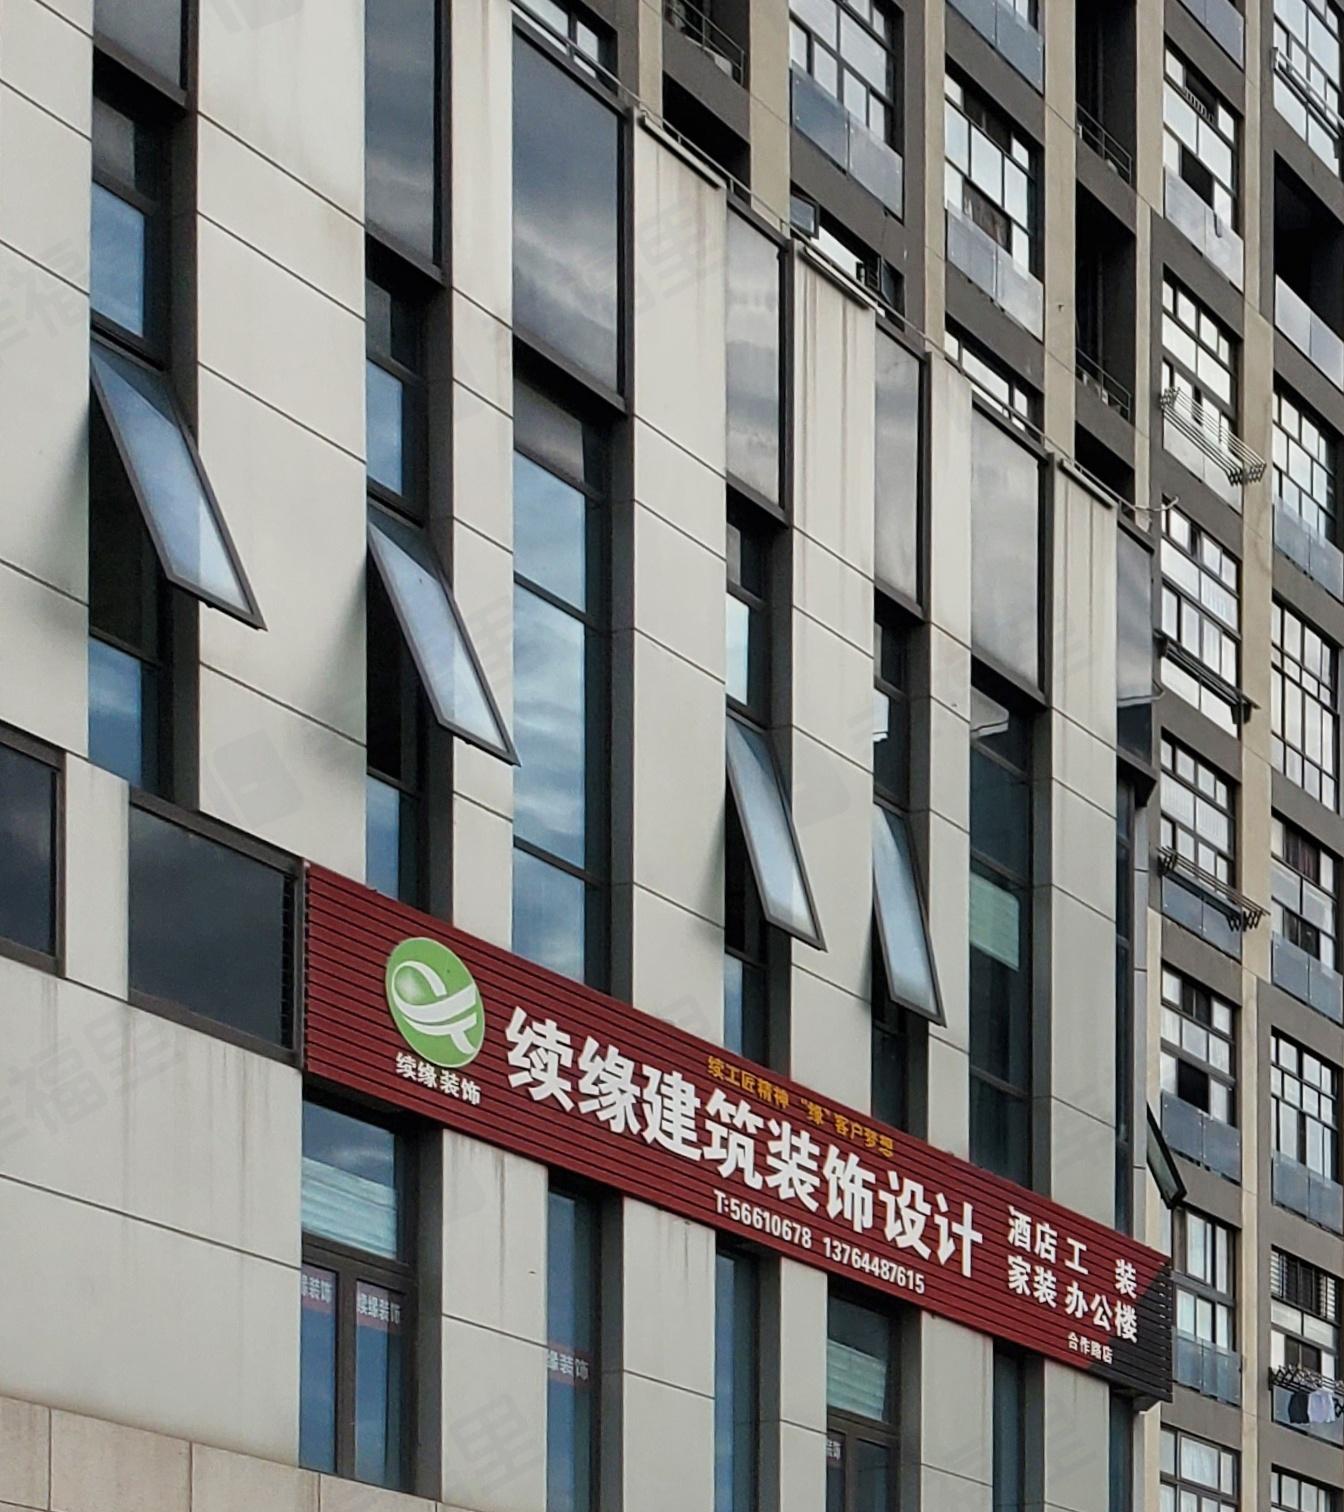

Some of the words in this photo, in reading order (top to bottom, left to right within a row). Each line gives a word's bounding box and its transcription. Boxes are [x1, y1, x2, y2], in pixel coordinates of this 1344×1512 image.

[396, 1052, 481, 1106] 续缘装饰
[505, 1005, 983, 1278] 续缘建筑装饰设计
[714, 1190, 812, 1249] T:56610678
[822, 1236, 925, 1294] 13764487615
[1008, 1205, 1058, 1264] 酒店
[1008, 1254, 1058, 1308] 家装
[1065, 1280, 1137, 1343] 办公楼
